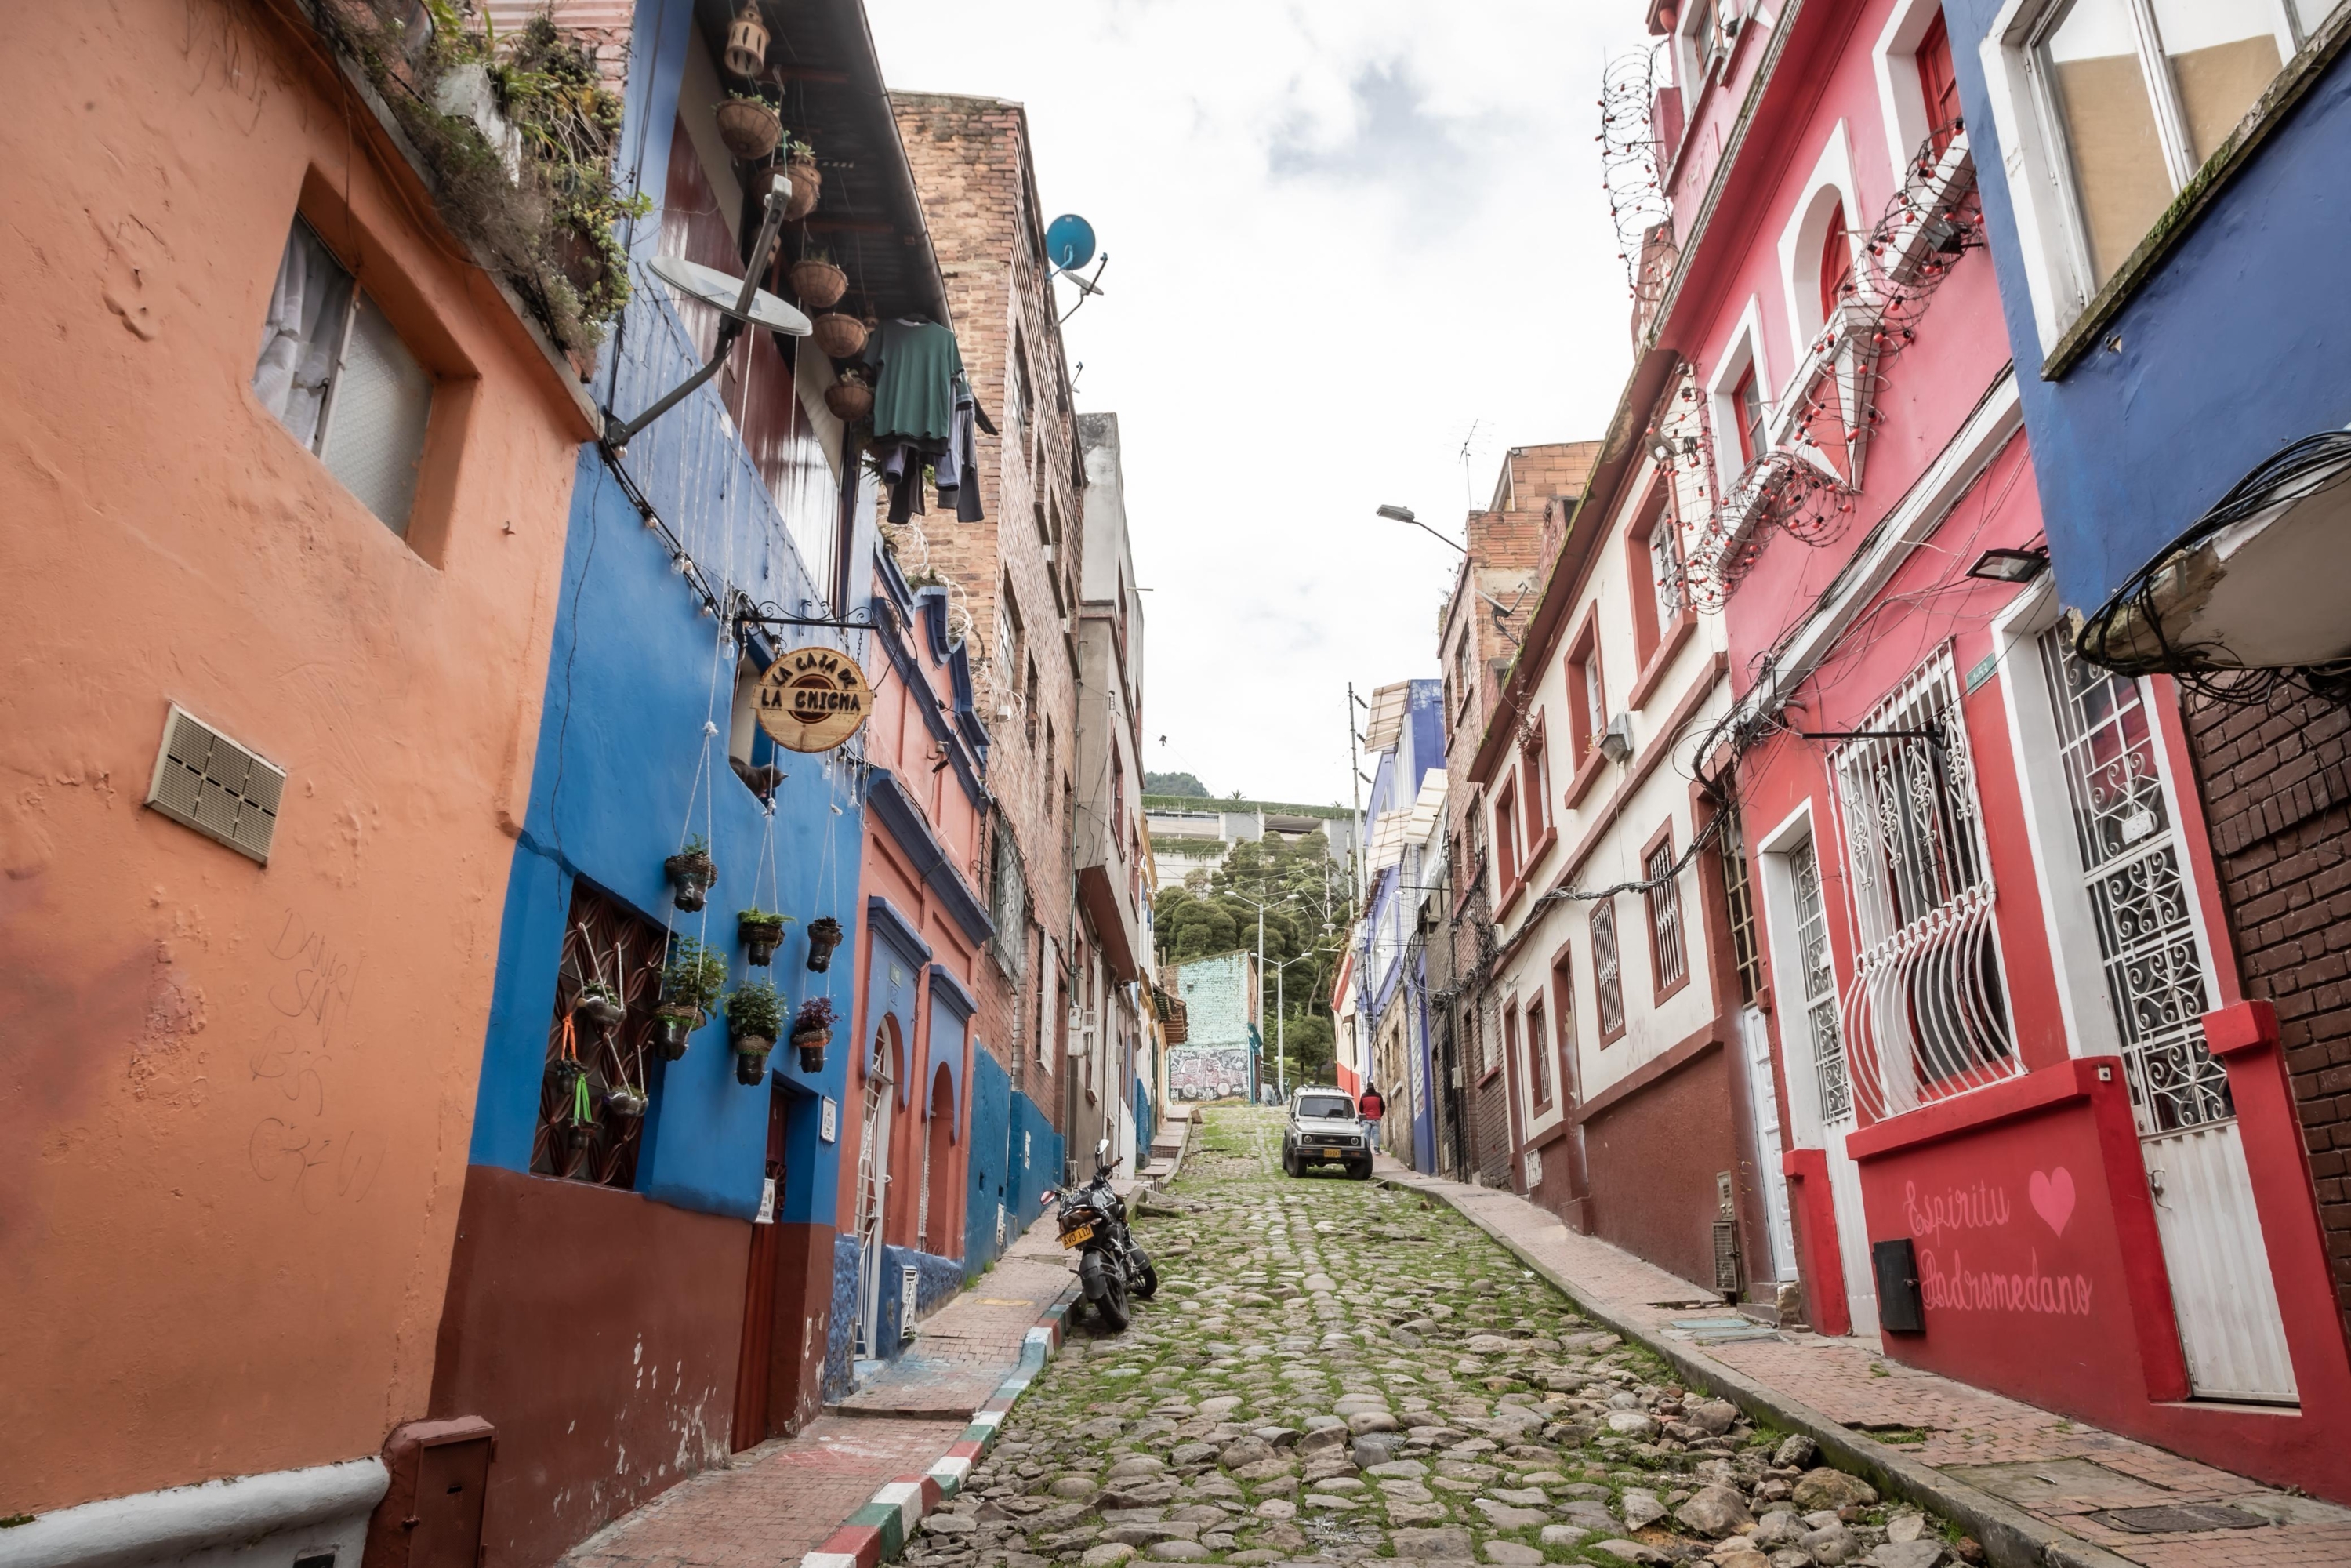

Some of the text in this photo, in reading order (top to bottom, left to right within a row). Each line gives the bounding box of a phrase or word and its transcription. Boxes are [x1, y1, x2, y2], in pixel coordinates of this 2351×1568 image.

[772, 652, 858, 688] LA CASA DE
[1973, 662, 1988, 683] 1-53
[761, 688, 861, 711] LA CHICHA
[1903, 1179, 2010, 1247] Espiritu
[1920, 1246, 2093, 1316] Andromedano
